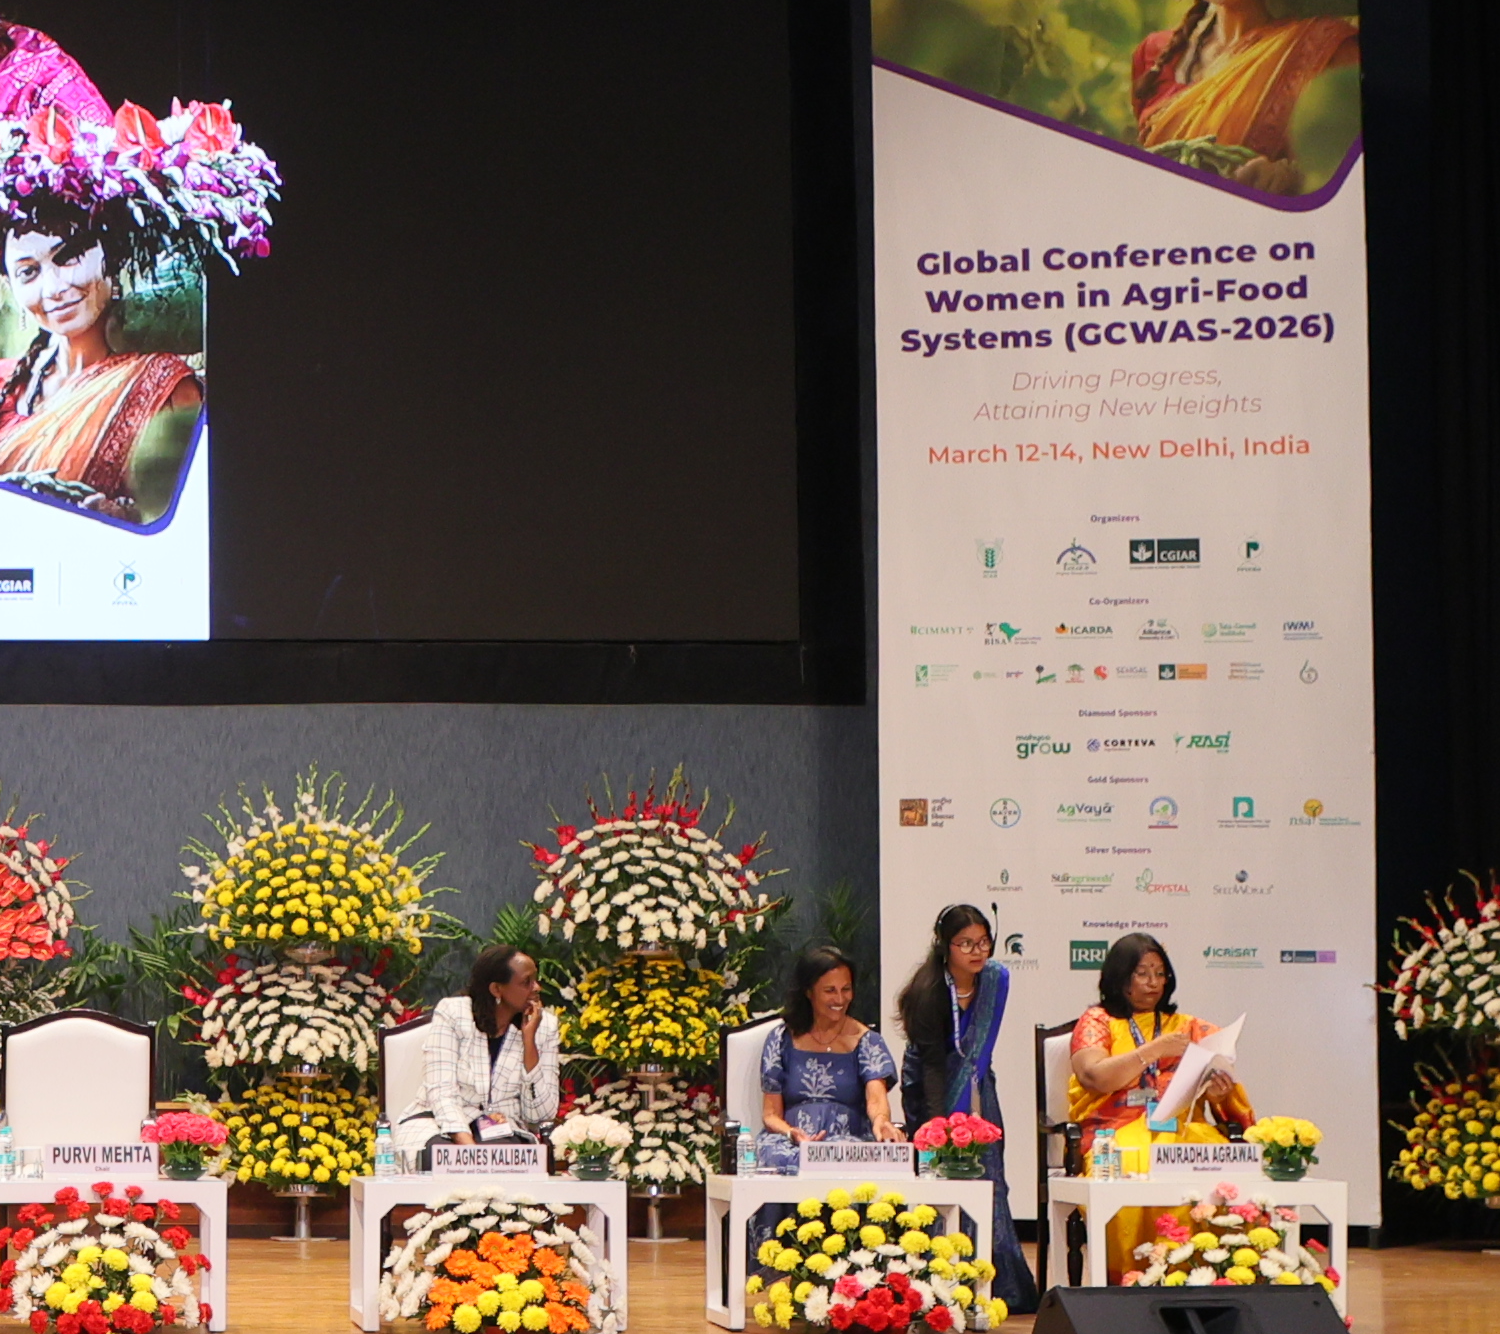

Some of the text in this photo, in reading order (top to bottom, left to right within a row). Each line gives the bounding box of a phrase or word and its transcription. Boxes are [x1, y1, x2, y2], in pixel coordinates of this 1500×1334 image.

[917, 242, 1314, 275] Global Conference on
[925, 275, 1307, 313] Women in Agri-Food
[901, 313, 1334, 357] Systems (GCWAS-2026)
[53, 1146, 151, 1163] PURVI MEHTA
[437, 1149, 538, 1165] DR. AGNES KALIBATA
[1157, 1147, 1258, 1163] ANURADHA AGRAWAL
